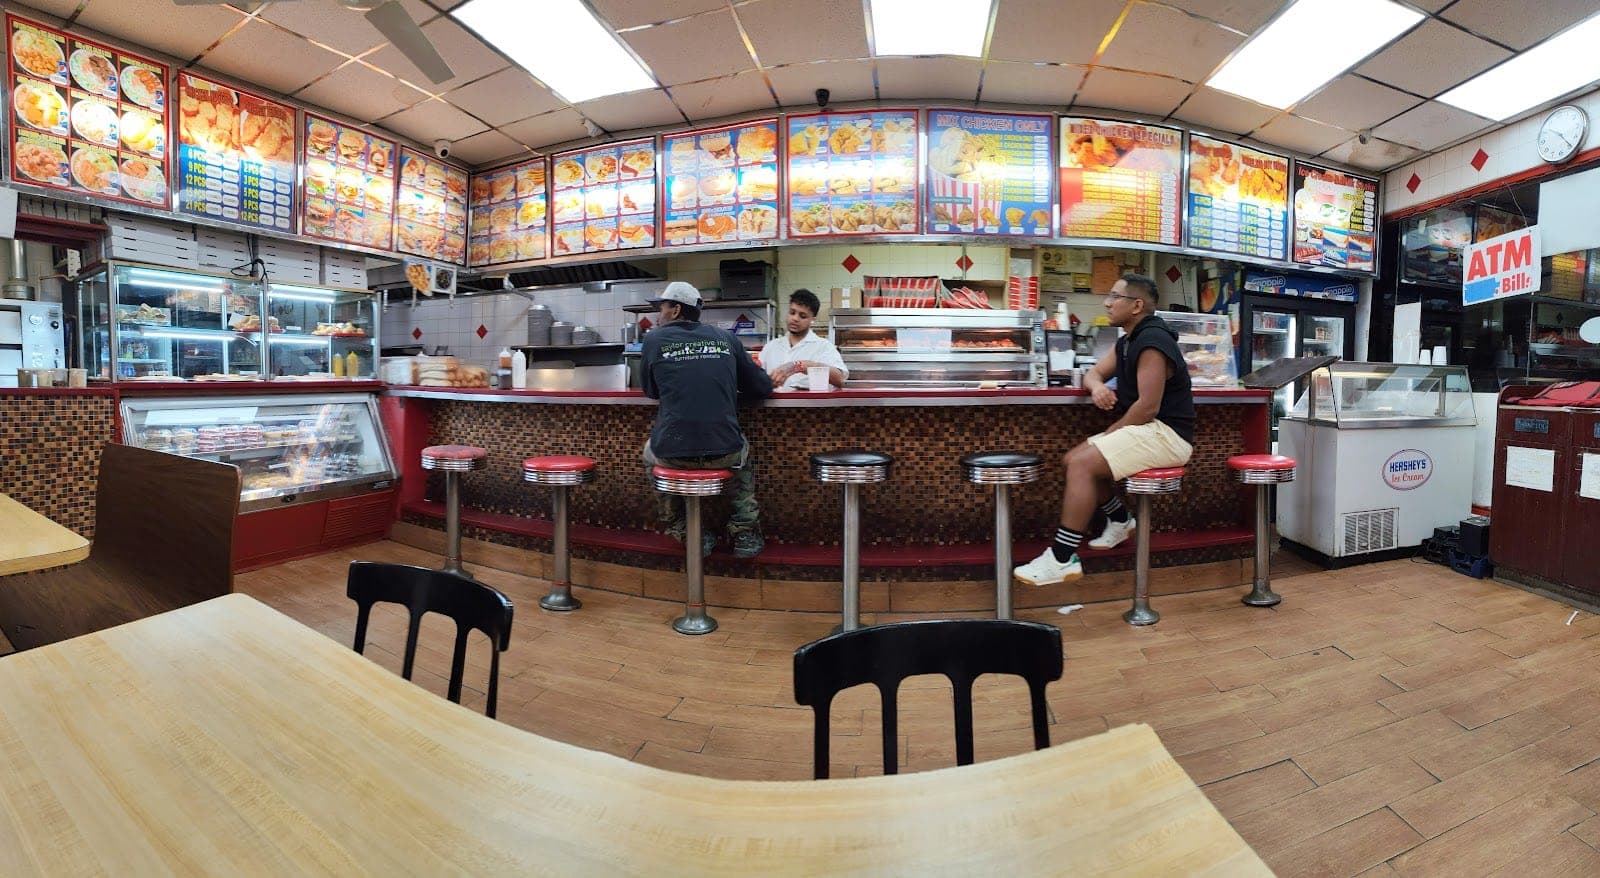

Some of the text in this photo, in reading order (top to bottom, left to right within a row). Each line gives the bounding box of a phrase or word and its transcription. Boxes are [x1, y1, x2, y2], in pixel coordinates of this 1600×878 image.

[961, 116, 1013, 131] CHICKEN
[1015, 120, 1048, 132] ONLY
[1095, 124, 1136, 140] CHICKEN
[1136, 127, 1175, 145] SPECIALS
[193, 162, 207, 174] PCS
[185, 173, 207, 187] 12 PCS
[248, 175, 259, 187] PCS
[248, 187, 259, 199] PCS
[185, 199, 207, 212] 21 PCS
[248, 199, 259, 211] PCS
[248, 211, 259, 223] PCS
[1467, 235, 1531, 281] ATM
[661, 342, 684, 352] taylor
[685, 340, 715, 348] creative
[1390, 459, 1426, 472] HERSHEY'S
[1391, 472, 1424, 483] Ice Cream
